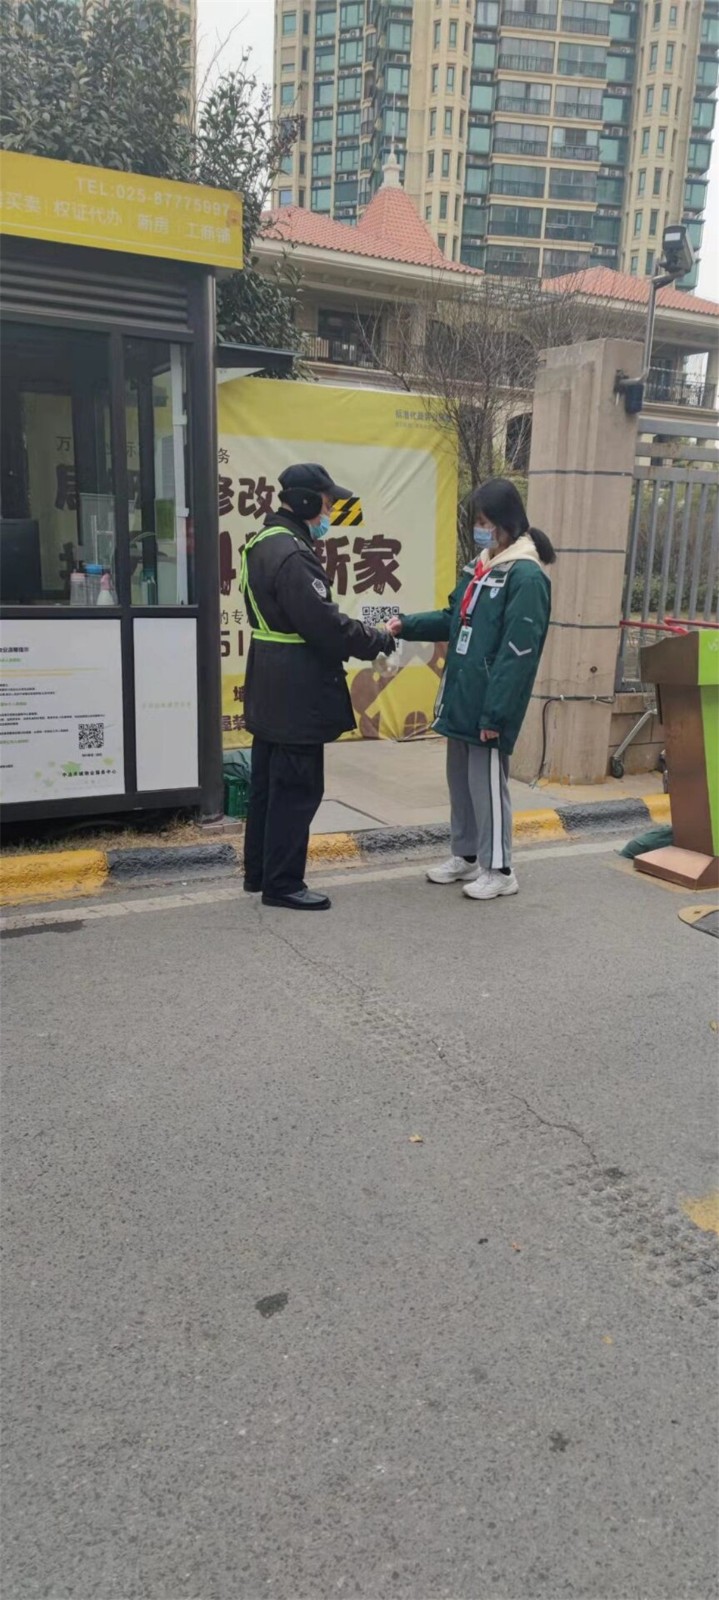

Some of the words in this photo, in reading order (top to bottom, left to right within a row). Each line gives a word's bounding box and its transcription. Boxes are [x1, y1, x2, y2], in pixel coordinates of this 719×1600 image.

[0, 188, 41, 213] 买卖
[54, 199, 122, 226] 权证代办
[137, 213, 169, 235] 新房
[218, 448, 230, 464] 务
